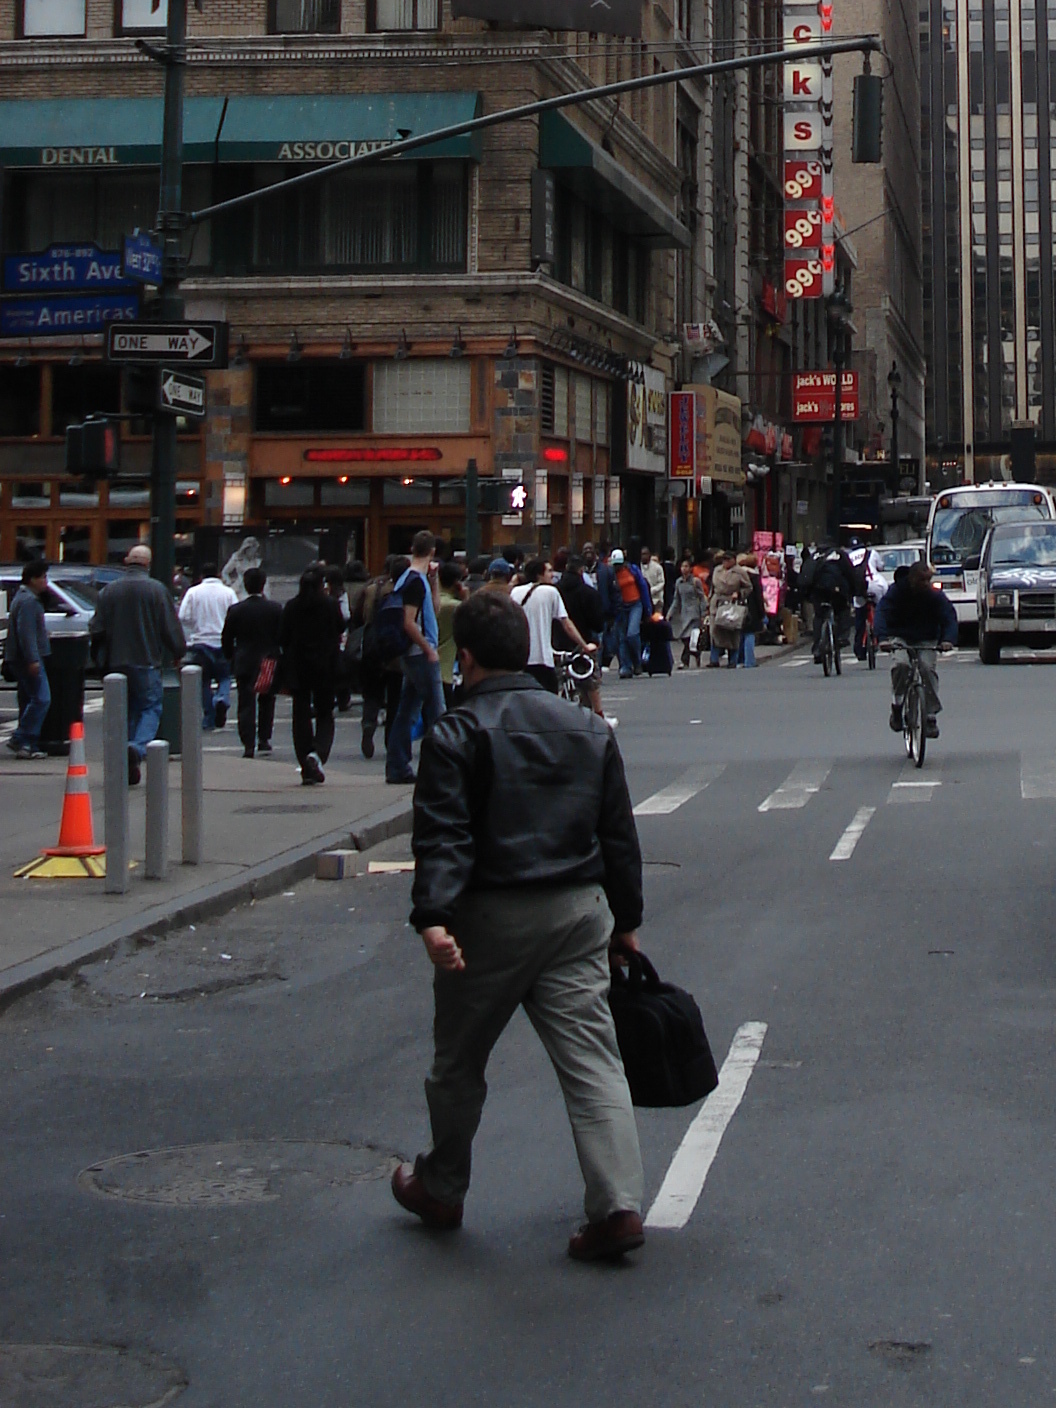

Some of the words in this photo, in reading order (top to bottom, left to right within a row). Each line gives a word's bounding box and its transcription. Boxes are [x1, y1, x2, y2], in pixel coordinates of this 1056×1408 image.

[41, 147, 119, 165] DENTAL
[278, 141, 402, 159] ASSOCIAT
[785, 161, 821, 198] 99¢
[785, 210, 821, 247] 99¢
[19, 260, 75, 282] Sixth
[86, 261, 124, 280] Ave
[786, 260, 822, 297] 99¢
[38, 305, 135, 326] Americas
[118, 336, 148, 349] ONE
[168, 337, 199, 349] WAY
[796, 374, 821, 389] jack's
[823, 373, 853, 386] WOLD
[168, 382, 181, 398] ONE
[188, 388, 202, 402] WAY
[796, 401, 819, 416] jack's
[833, 402, 855, 412] sores
